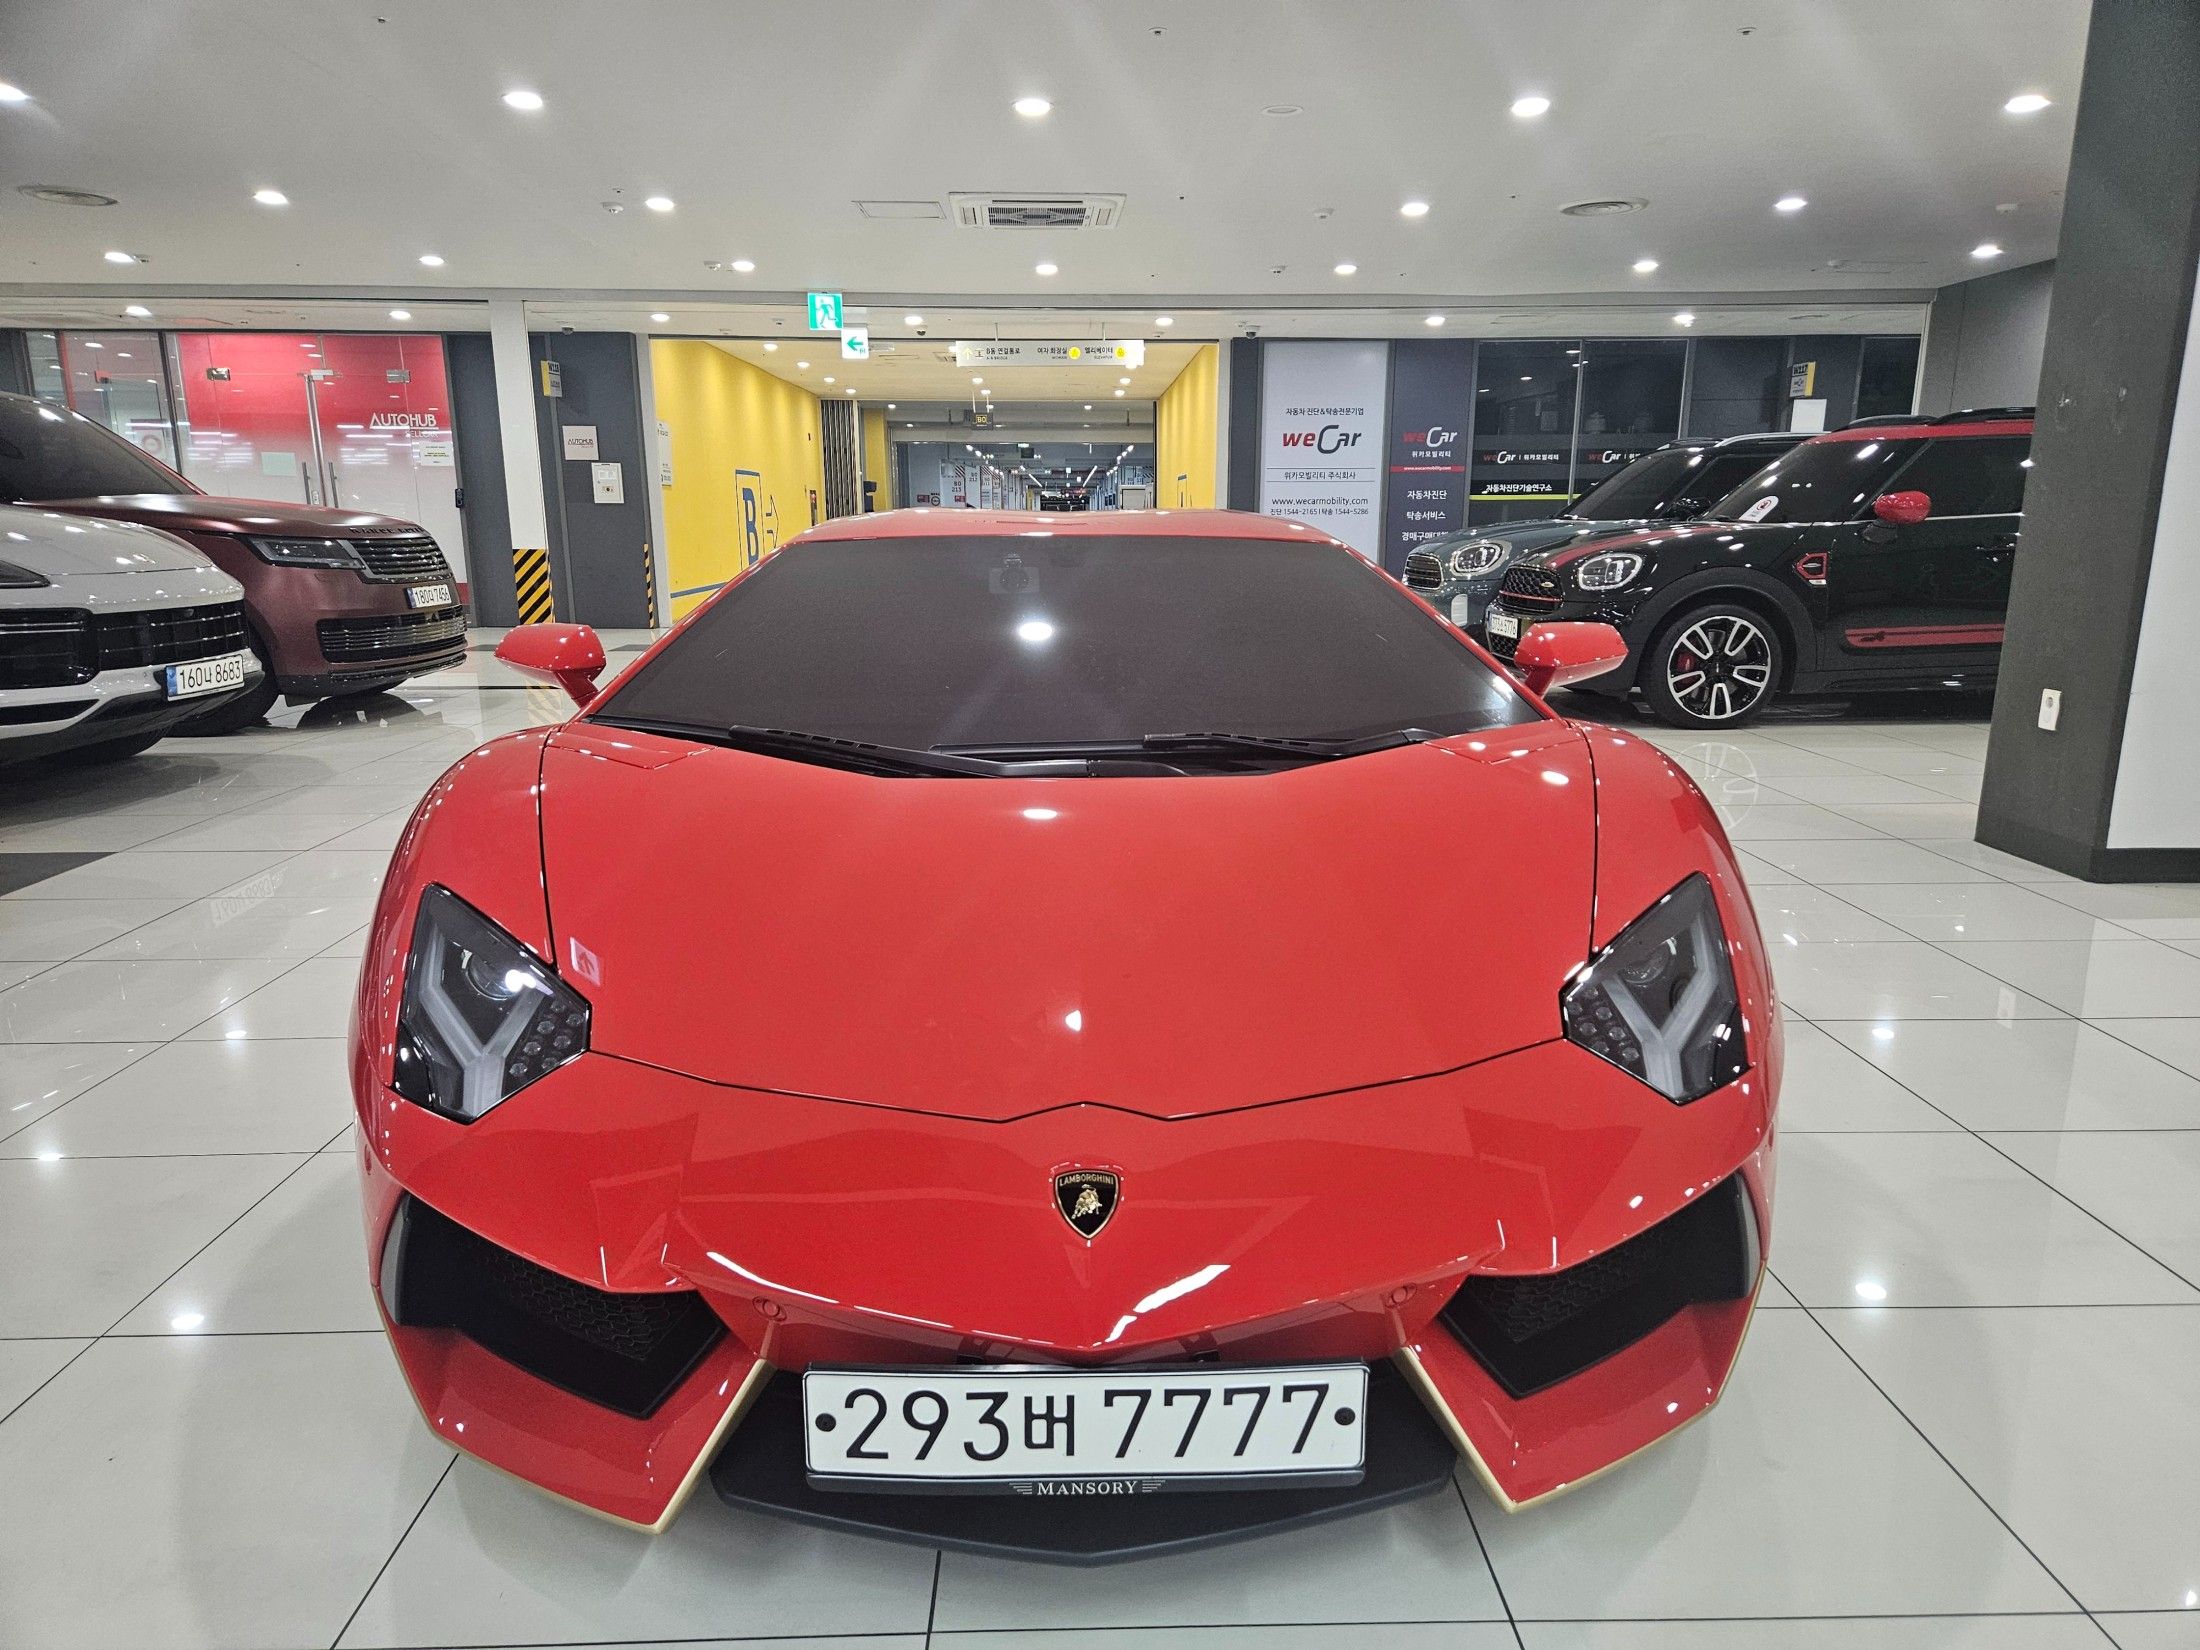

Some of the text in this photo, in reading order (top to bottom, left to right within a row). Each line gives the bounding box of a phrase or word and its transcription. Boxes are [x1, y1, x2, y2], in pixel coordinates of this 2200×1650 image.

[1050, 346, 1068, 355] 화장실
[1084, 346, 1113, 354] 엘리베이터
[1286, 408, 1305, 416] 자동차
[370, 412, 437, 428] AUTOHUB
[1412, 450, 1452, 458] 위카모빌리티
[1523, 453, 1559, 461] 위카모빌리티
[1284, 471, 1356, 480] 위카모빌리티 주식회사
[1486, 483, 1553, 493] 자동차진단기술연구소
[1407, 490, 1447, 500] 자동차진단
[1272, 497, 1368, 506] www.wecarmobility.com
[1406, 511, 1446, 520] 탁송서비스
[215, 661, 241, 683] 8683
[1059, 1173, 1114, 1187] LAMBORGHINI
[844, 1383, 1330, 1461] 293버 7777
[1037, 1479, 1138, 1496] MANSORY
